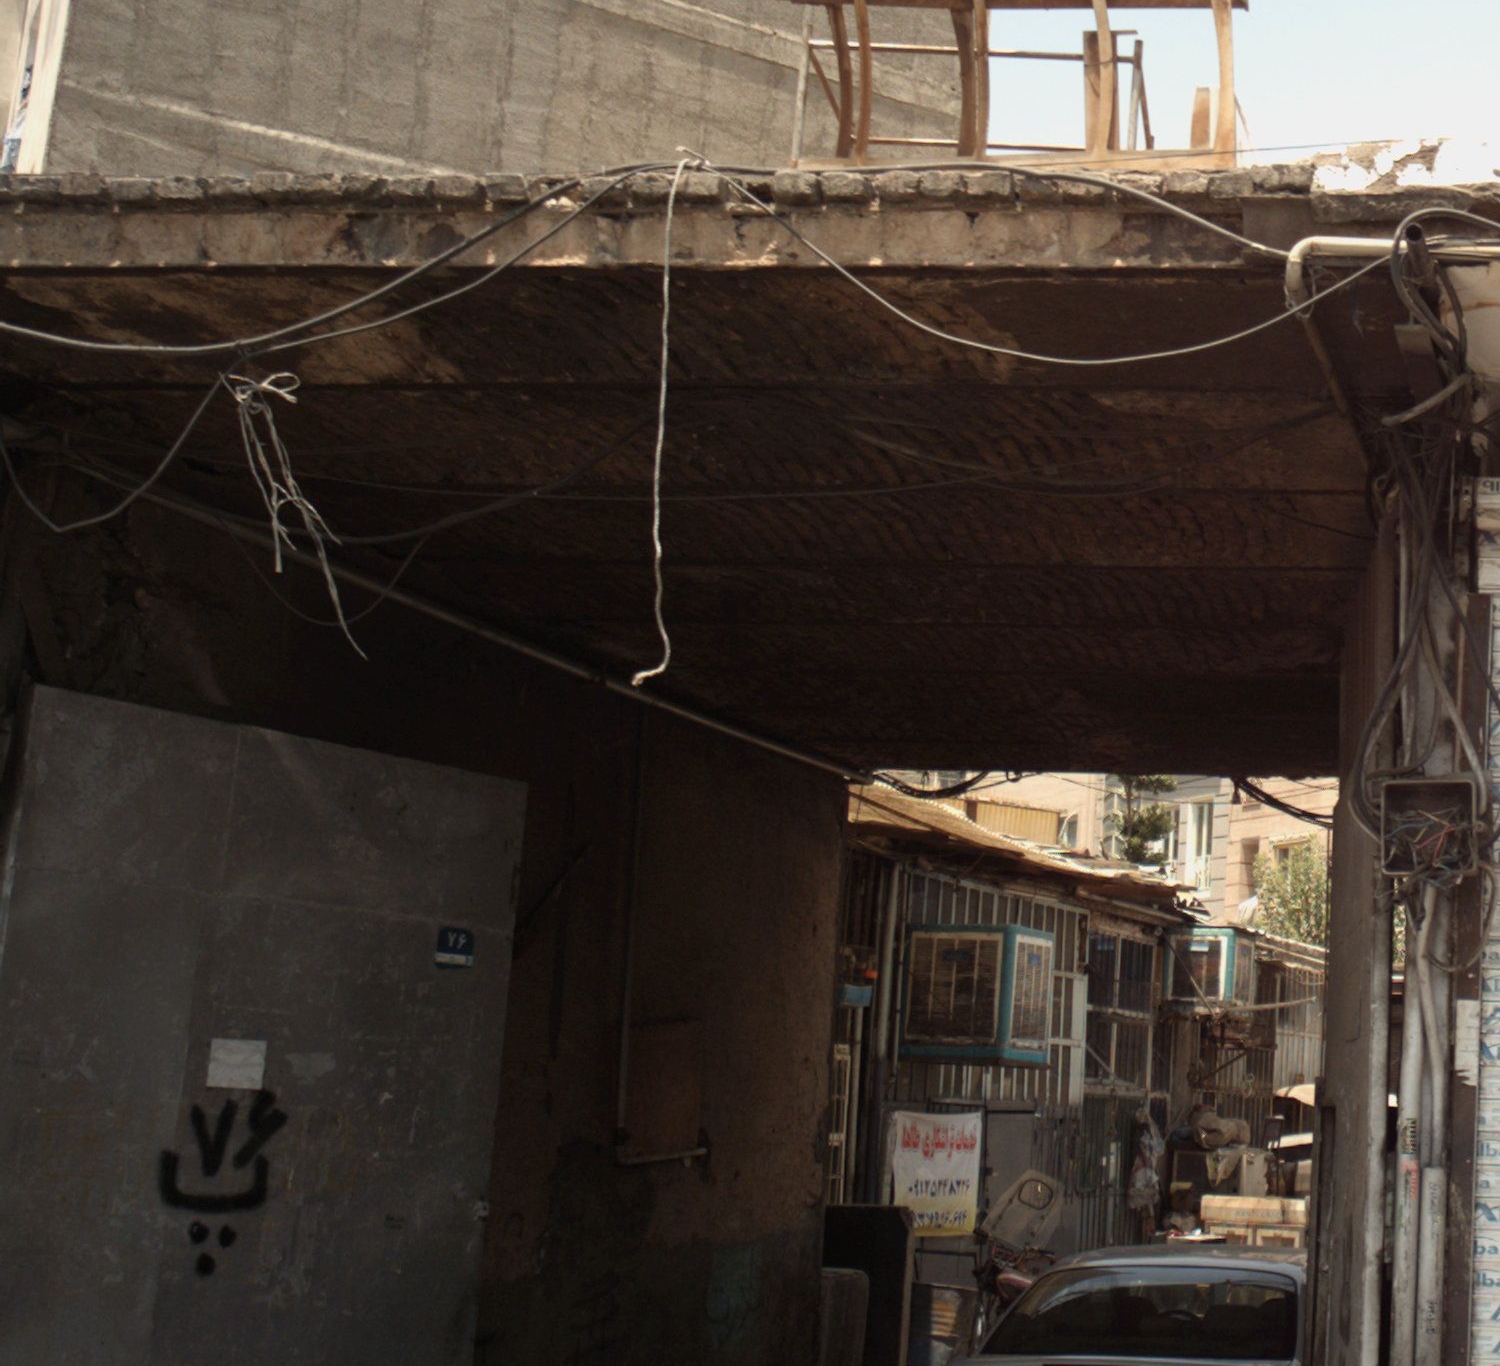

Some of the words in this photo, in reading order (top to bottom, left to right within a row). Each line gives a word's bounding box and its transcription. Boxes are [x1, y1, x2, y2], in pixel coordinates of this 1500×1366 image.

[447, 931, 467, 949] ۷۶
[190, 1088, 288, 1176] ۷۶
[160, 1149, 269, 1277] پ
